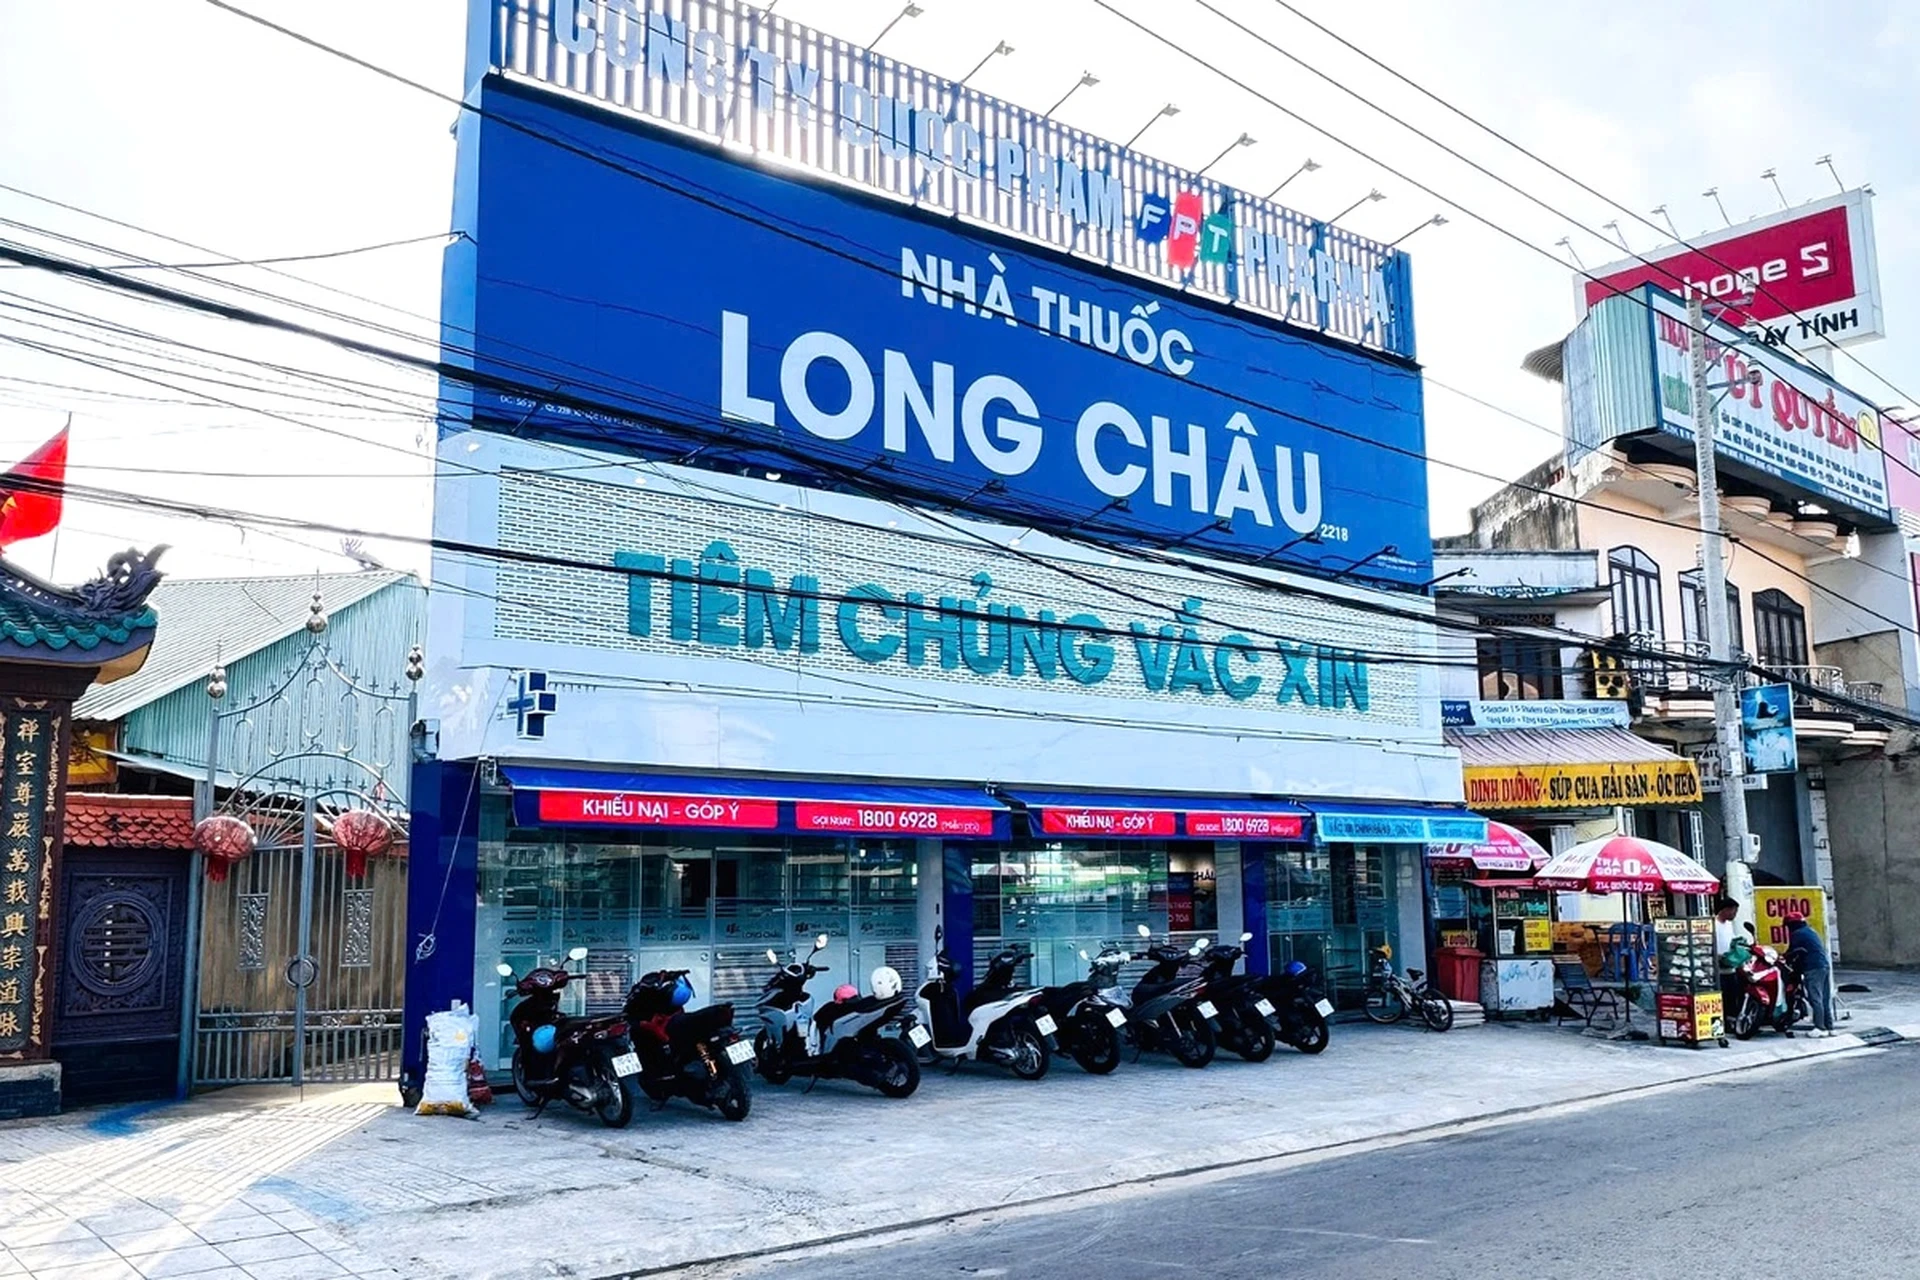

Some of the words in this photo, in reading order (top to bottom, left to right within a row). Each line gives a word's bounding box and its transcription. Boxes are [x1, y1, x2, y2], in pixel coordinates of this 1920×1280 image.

[747, 45, 819, 129] TY
[1140, 203, 1228, 253] FPT
[1243, 224, 1389, 325] PHARMA
[902, 247, 1017, 327] NHÀ
[1031, 286, 1194, 376] THUỐC
[1797, 308, 1858, 339] TÍNH
[721, 310, 1043, 476] LONG
[1075, 401, 1322, 534] CHÂU
[1320, 523, 1348, 541] 2218
[614, 540, 820, 654] TIÊM
[837, 571, 1115, 687] CHỦNG
[1129, 595, 1262, 701] VẮC
[1275, 640, 1369, 713] XIN
[1471, 779, 1498, 802] DINH
[1550, 770, 1572, 800] SÚP
[1575, 776, 1599, 799] CUA
[583, 793, 633, 816] KHIẾU
[638, 801, 668, 823] NẠI
[685, 801, 724, 819] GÓP
[729, 801, 739, 820] Ý
[857, 809, 895, 828] 1800
[899, 812, 938, 829] 6928
[1066, 809, 1095, 828] KHIẾU
[1096, 815, 1114, 833] NẠI
[1123, 813, 1146, 829] GÓP
[1147, 813, 1154, 830] Ý
[1221, 817, 1243, 832] 1800
